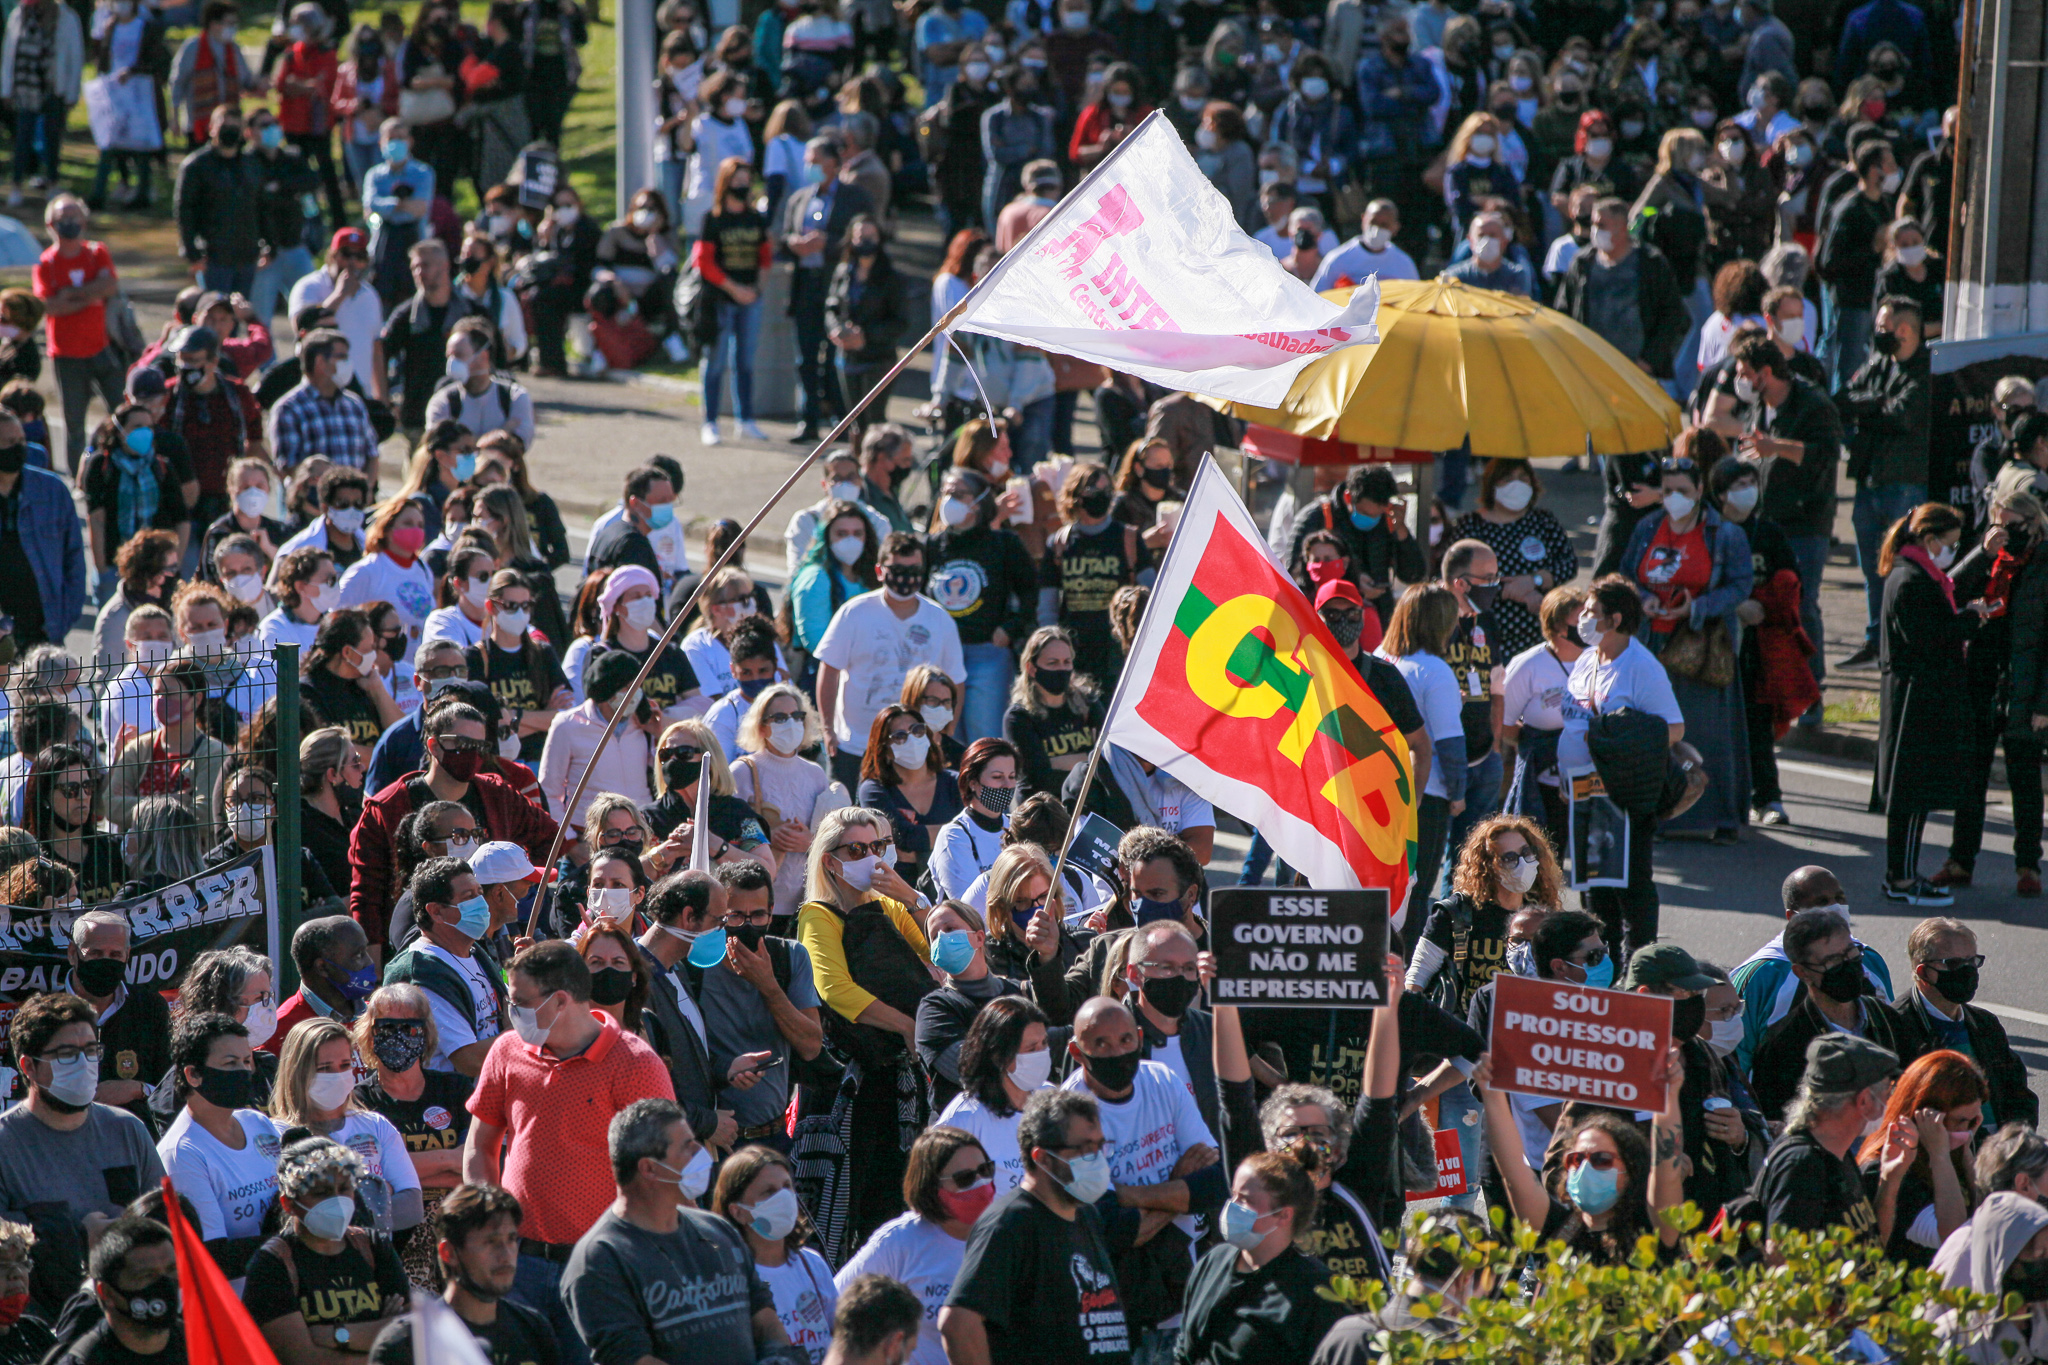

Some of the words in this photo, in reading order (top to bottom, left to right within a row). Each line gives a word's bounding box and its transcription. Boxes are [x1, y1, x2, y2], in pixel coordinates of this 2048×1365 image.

[1094, 837, 1119, 861] MA
[1269, 896, 1329, 917] ESSE
[1233, 923, 1364, 945] GOVERNO
[1250, 947, 1309, 971] NÃO
[1317, 952, 1357, 972] ME
[1218, 979, 1379, 1000] REPRESENTA
[1553, 991, 1610, 1016] SOU
[1505, 1011, 1656, 1050] PROFESSOR
[1531, 1043, 1625, 1073] QUERO
[1515, 1067, 1638, 1101] RESPEITO
[228, 1181, 267, 1200] NOSSOS
[234, 1198, 255, 1221] SÓ
[1083, 1328, 1094, 1340] O
